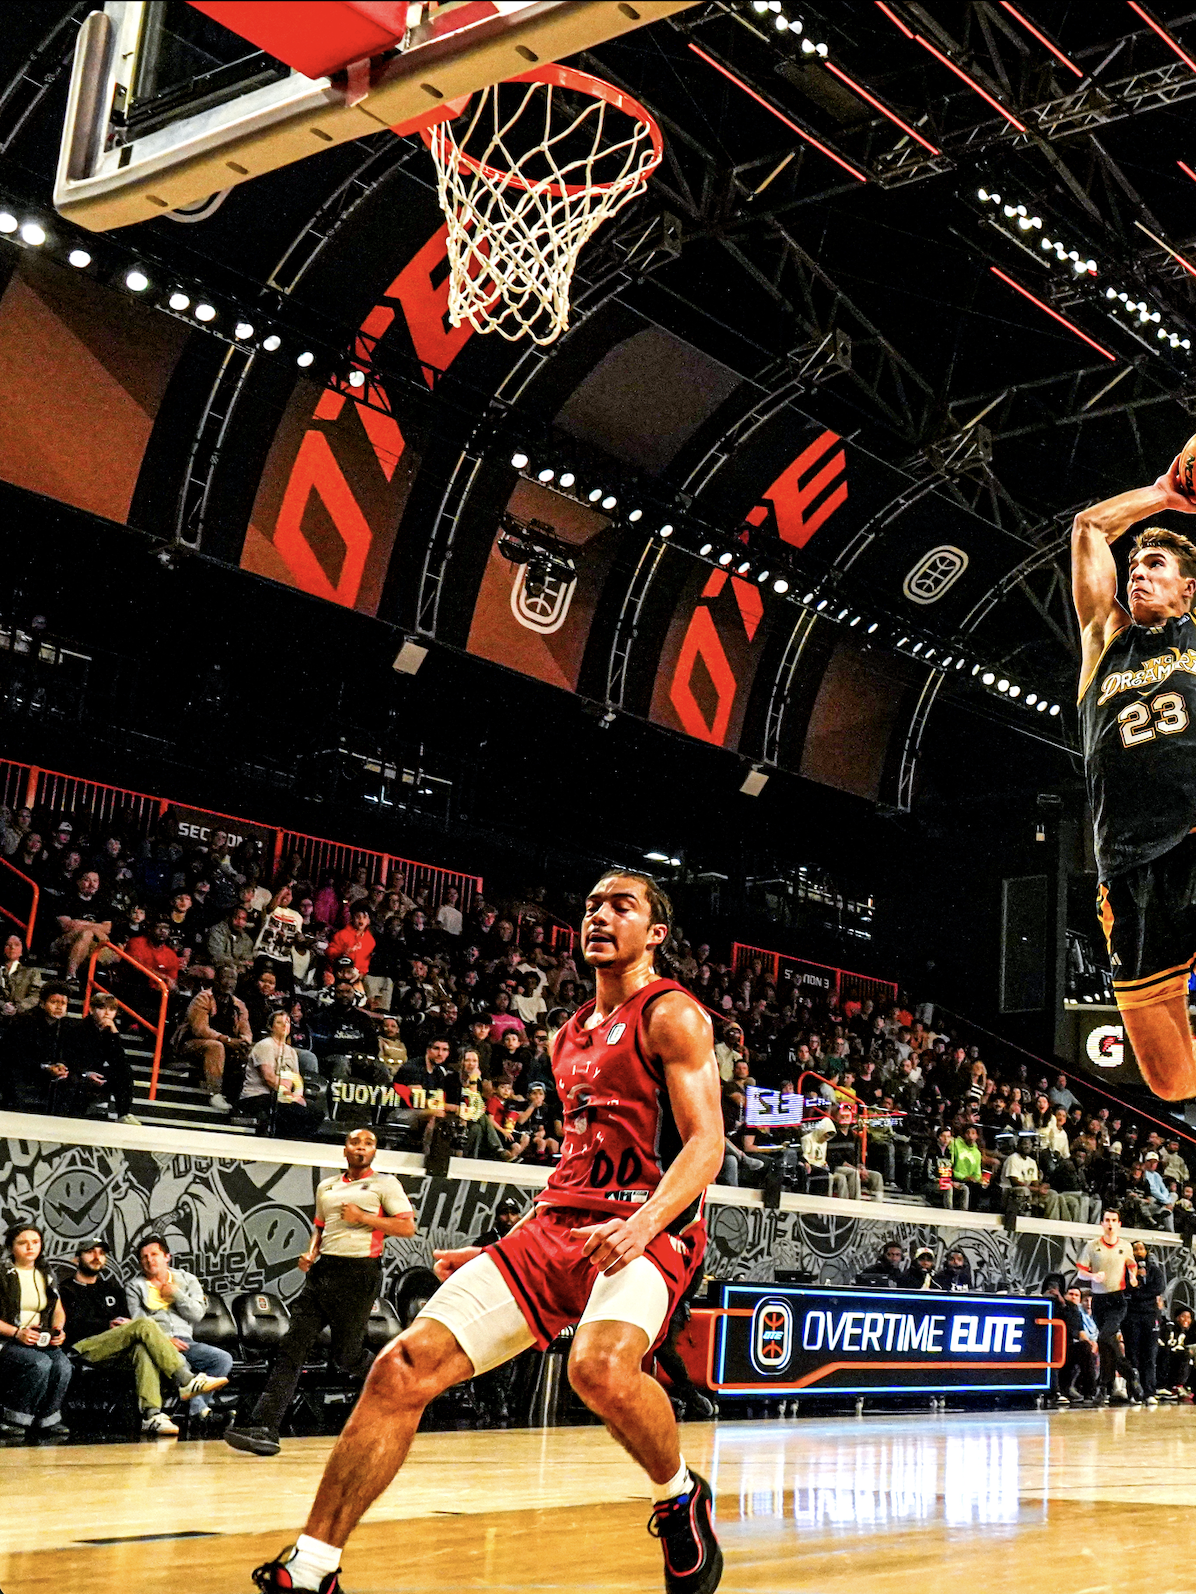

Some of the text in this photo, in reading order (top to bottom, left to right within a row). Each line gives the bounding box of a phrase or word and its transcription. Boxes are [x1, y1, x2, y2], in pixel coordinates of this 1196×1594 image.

[1143, 655, 1174, 670] YNG
[1118, 691, 1190, 748] 23
[1086, 1024, 1124, 1068] G
[763, 1330, 784, 1340] OTE
[803, 1311, 1025, 1353] OVERTIME ELITE
